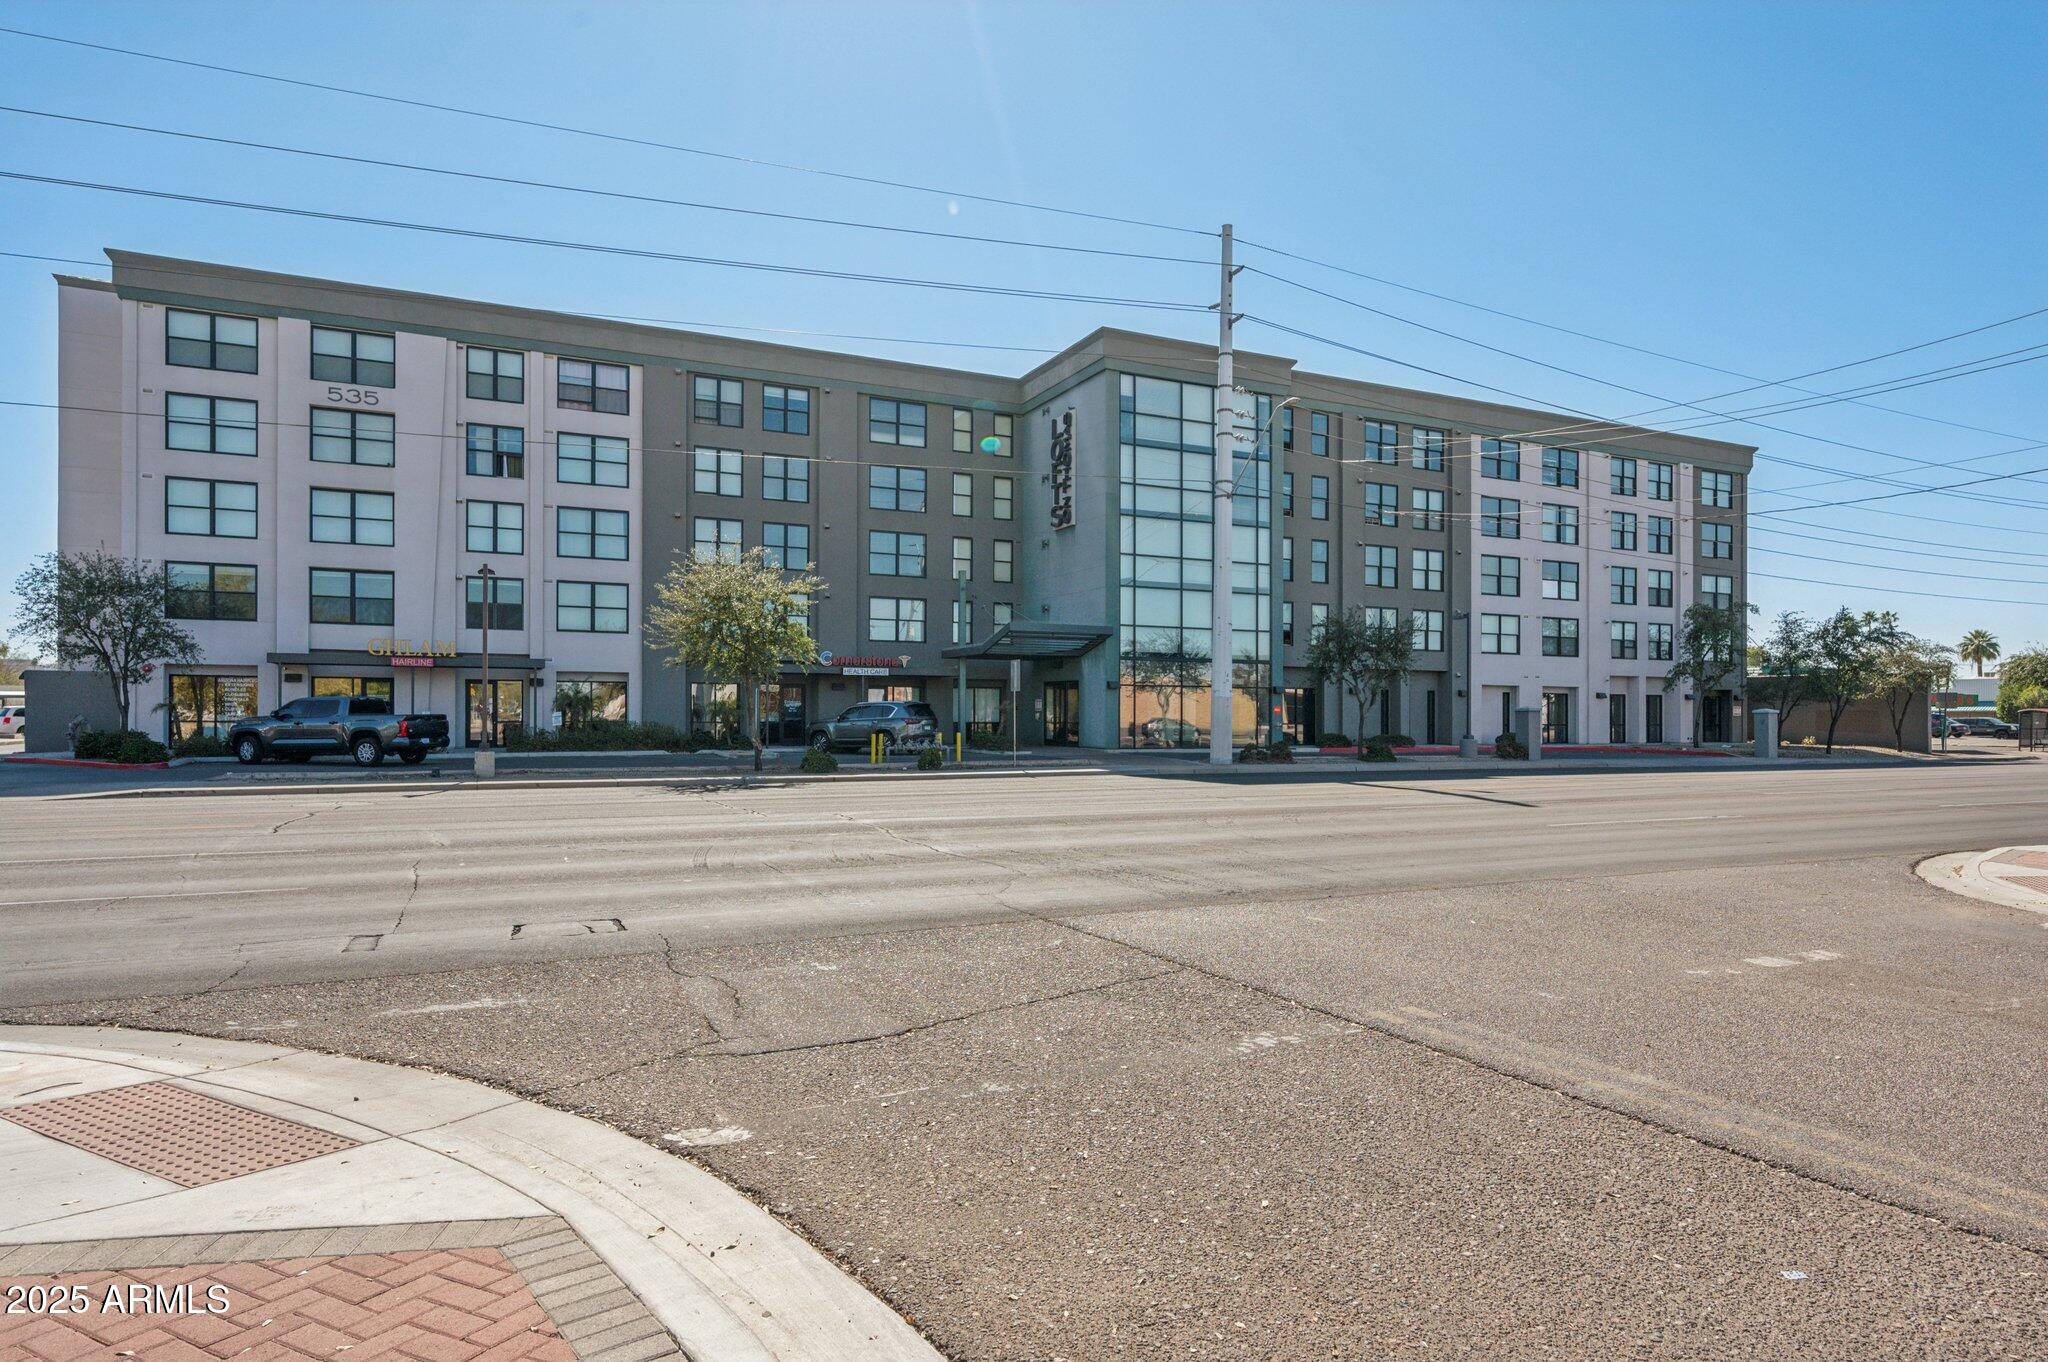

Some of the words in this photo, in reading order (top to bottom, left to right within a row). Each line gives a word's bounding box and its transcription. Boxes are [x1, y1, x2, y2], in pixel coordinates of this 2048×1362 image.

[327, 386, 379, 405] 535
[1051, 419, 1065, 527] LOFTS
[392, 657, 433, 667] HAIRLINE
[844, 667, 869, 675] HEALTH
